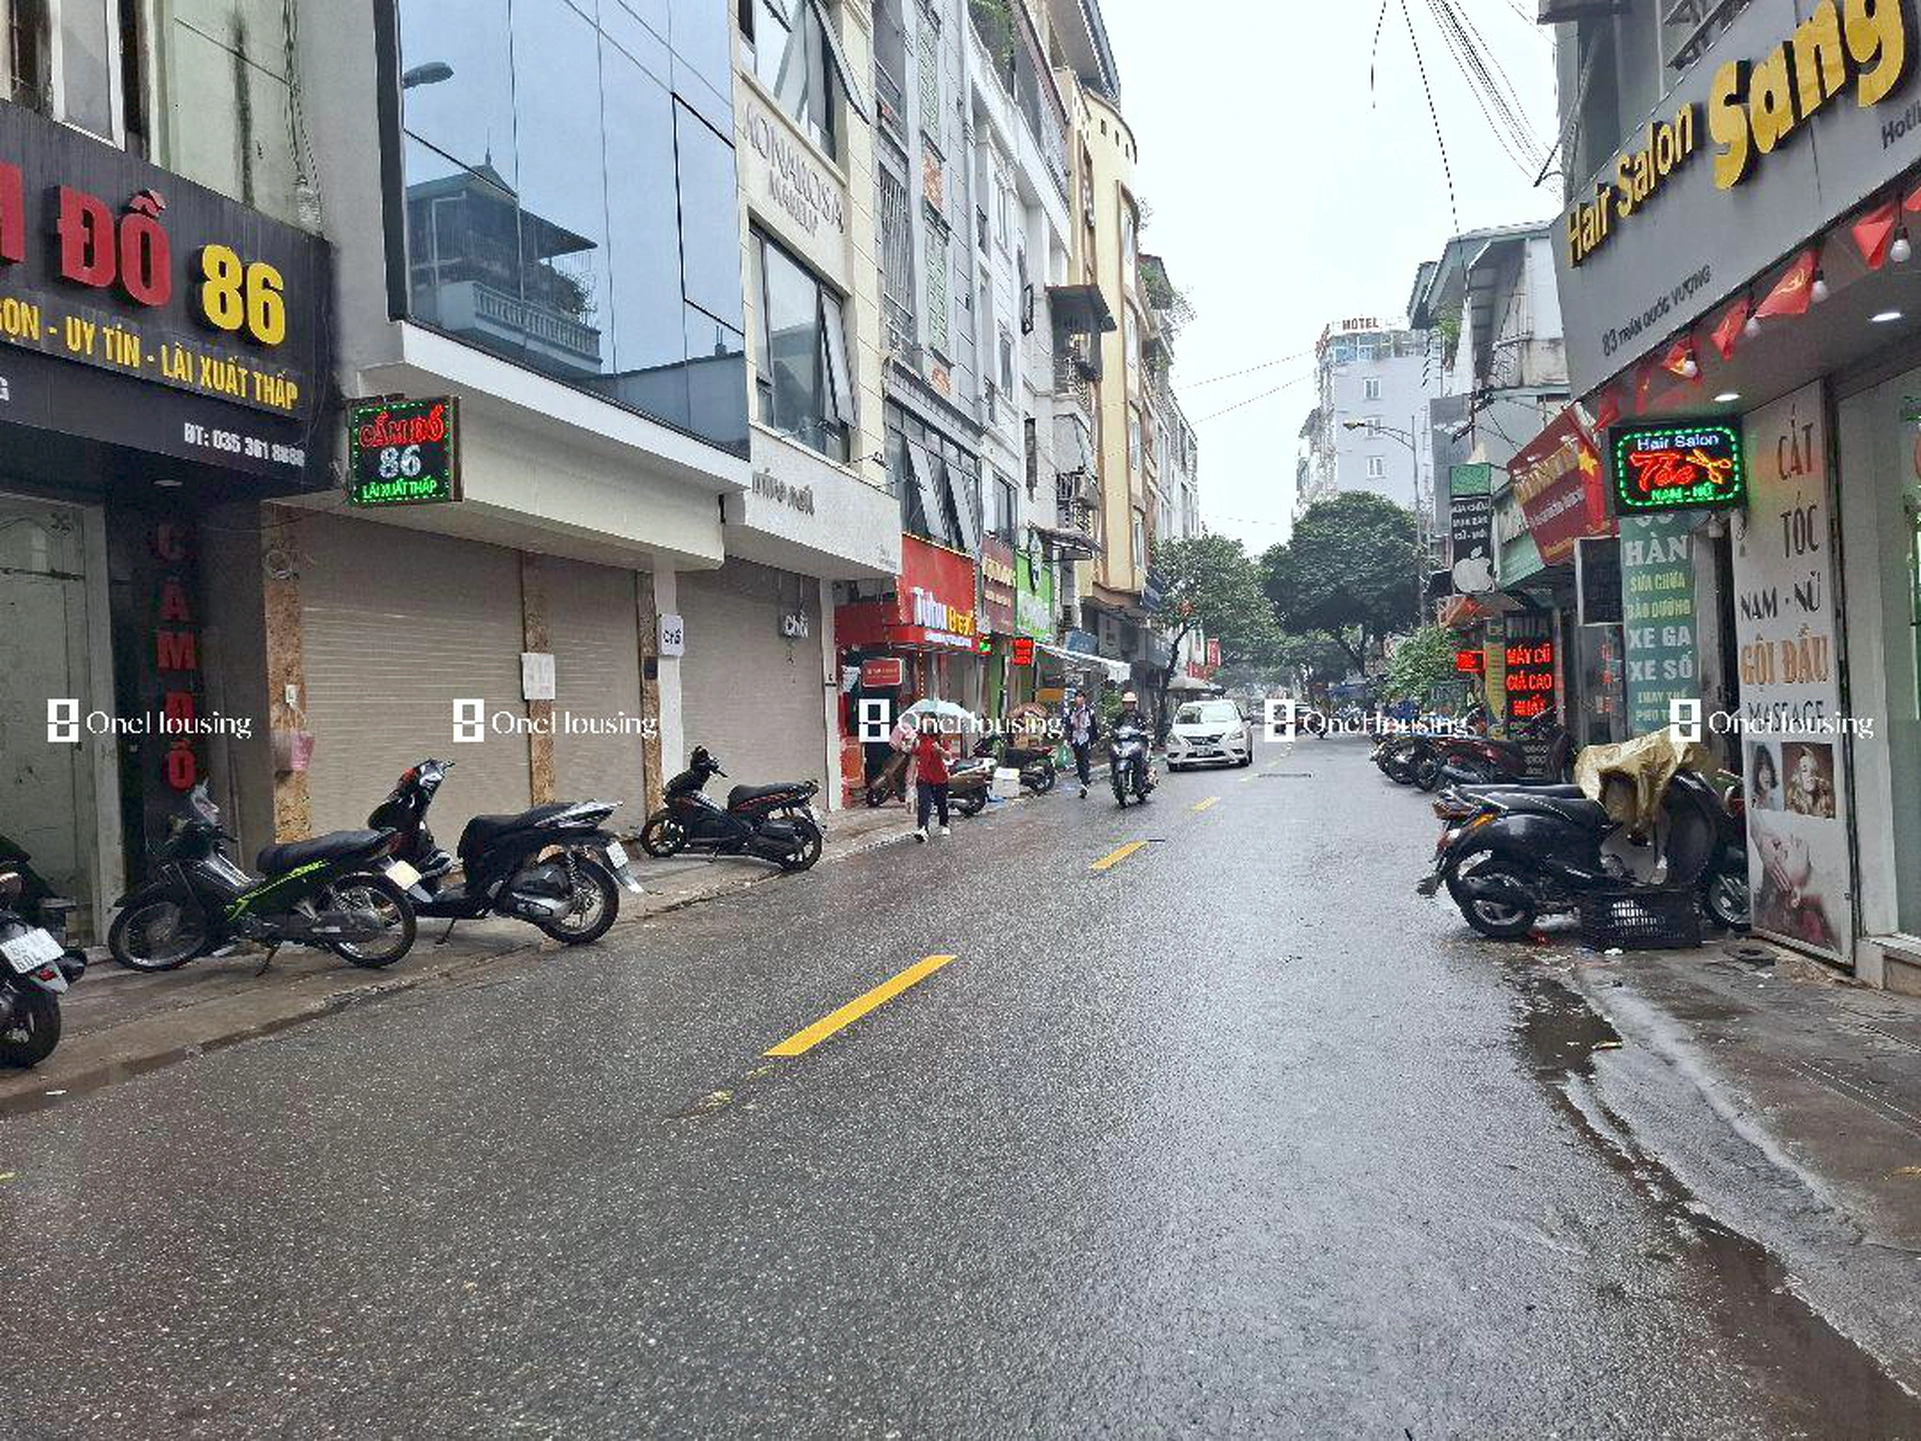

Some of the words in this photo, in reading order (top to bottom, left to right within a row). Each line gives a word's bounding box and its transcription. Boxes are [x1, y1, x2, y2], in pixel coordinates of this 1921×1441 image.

[1566, 186, 1611, 268] Hair
[1616, 103, 1694, 219] Salon
[1708, 0, 1906, 191] Sang
[57, 187, 172, 307] ĐỒ
[201, 244, 286, 346] 86
[1342, 317, 1379, 331] HOTEL
[0, 297, 40, 343] ỌN
[65, 316, 96, 355] UY
[200, 355, 248, 398] XUẤT
[254, 370, 299, 411] THẤP
[1602, 328, 1618, 357] 83
[1637, 436, 1669, 451] Hair
[1675, 433, 1719, 448] Salon
[1777, 402, 1815, 481] CẮT
[379, 444, 421, 478] 86
[1780, 490, 1820, 559] TÓC
[1624, 532, 1689, 567] HÀN
[1740, 588, 1778, 622] NAM
[1628, 627, 1656, 649] XE
[1661, 626, 1693, 647] GA
[1628, 659, 1657, 682] XE
[1662, 651, 1694, 681] SỐ
